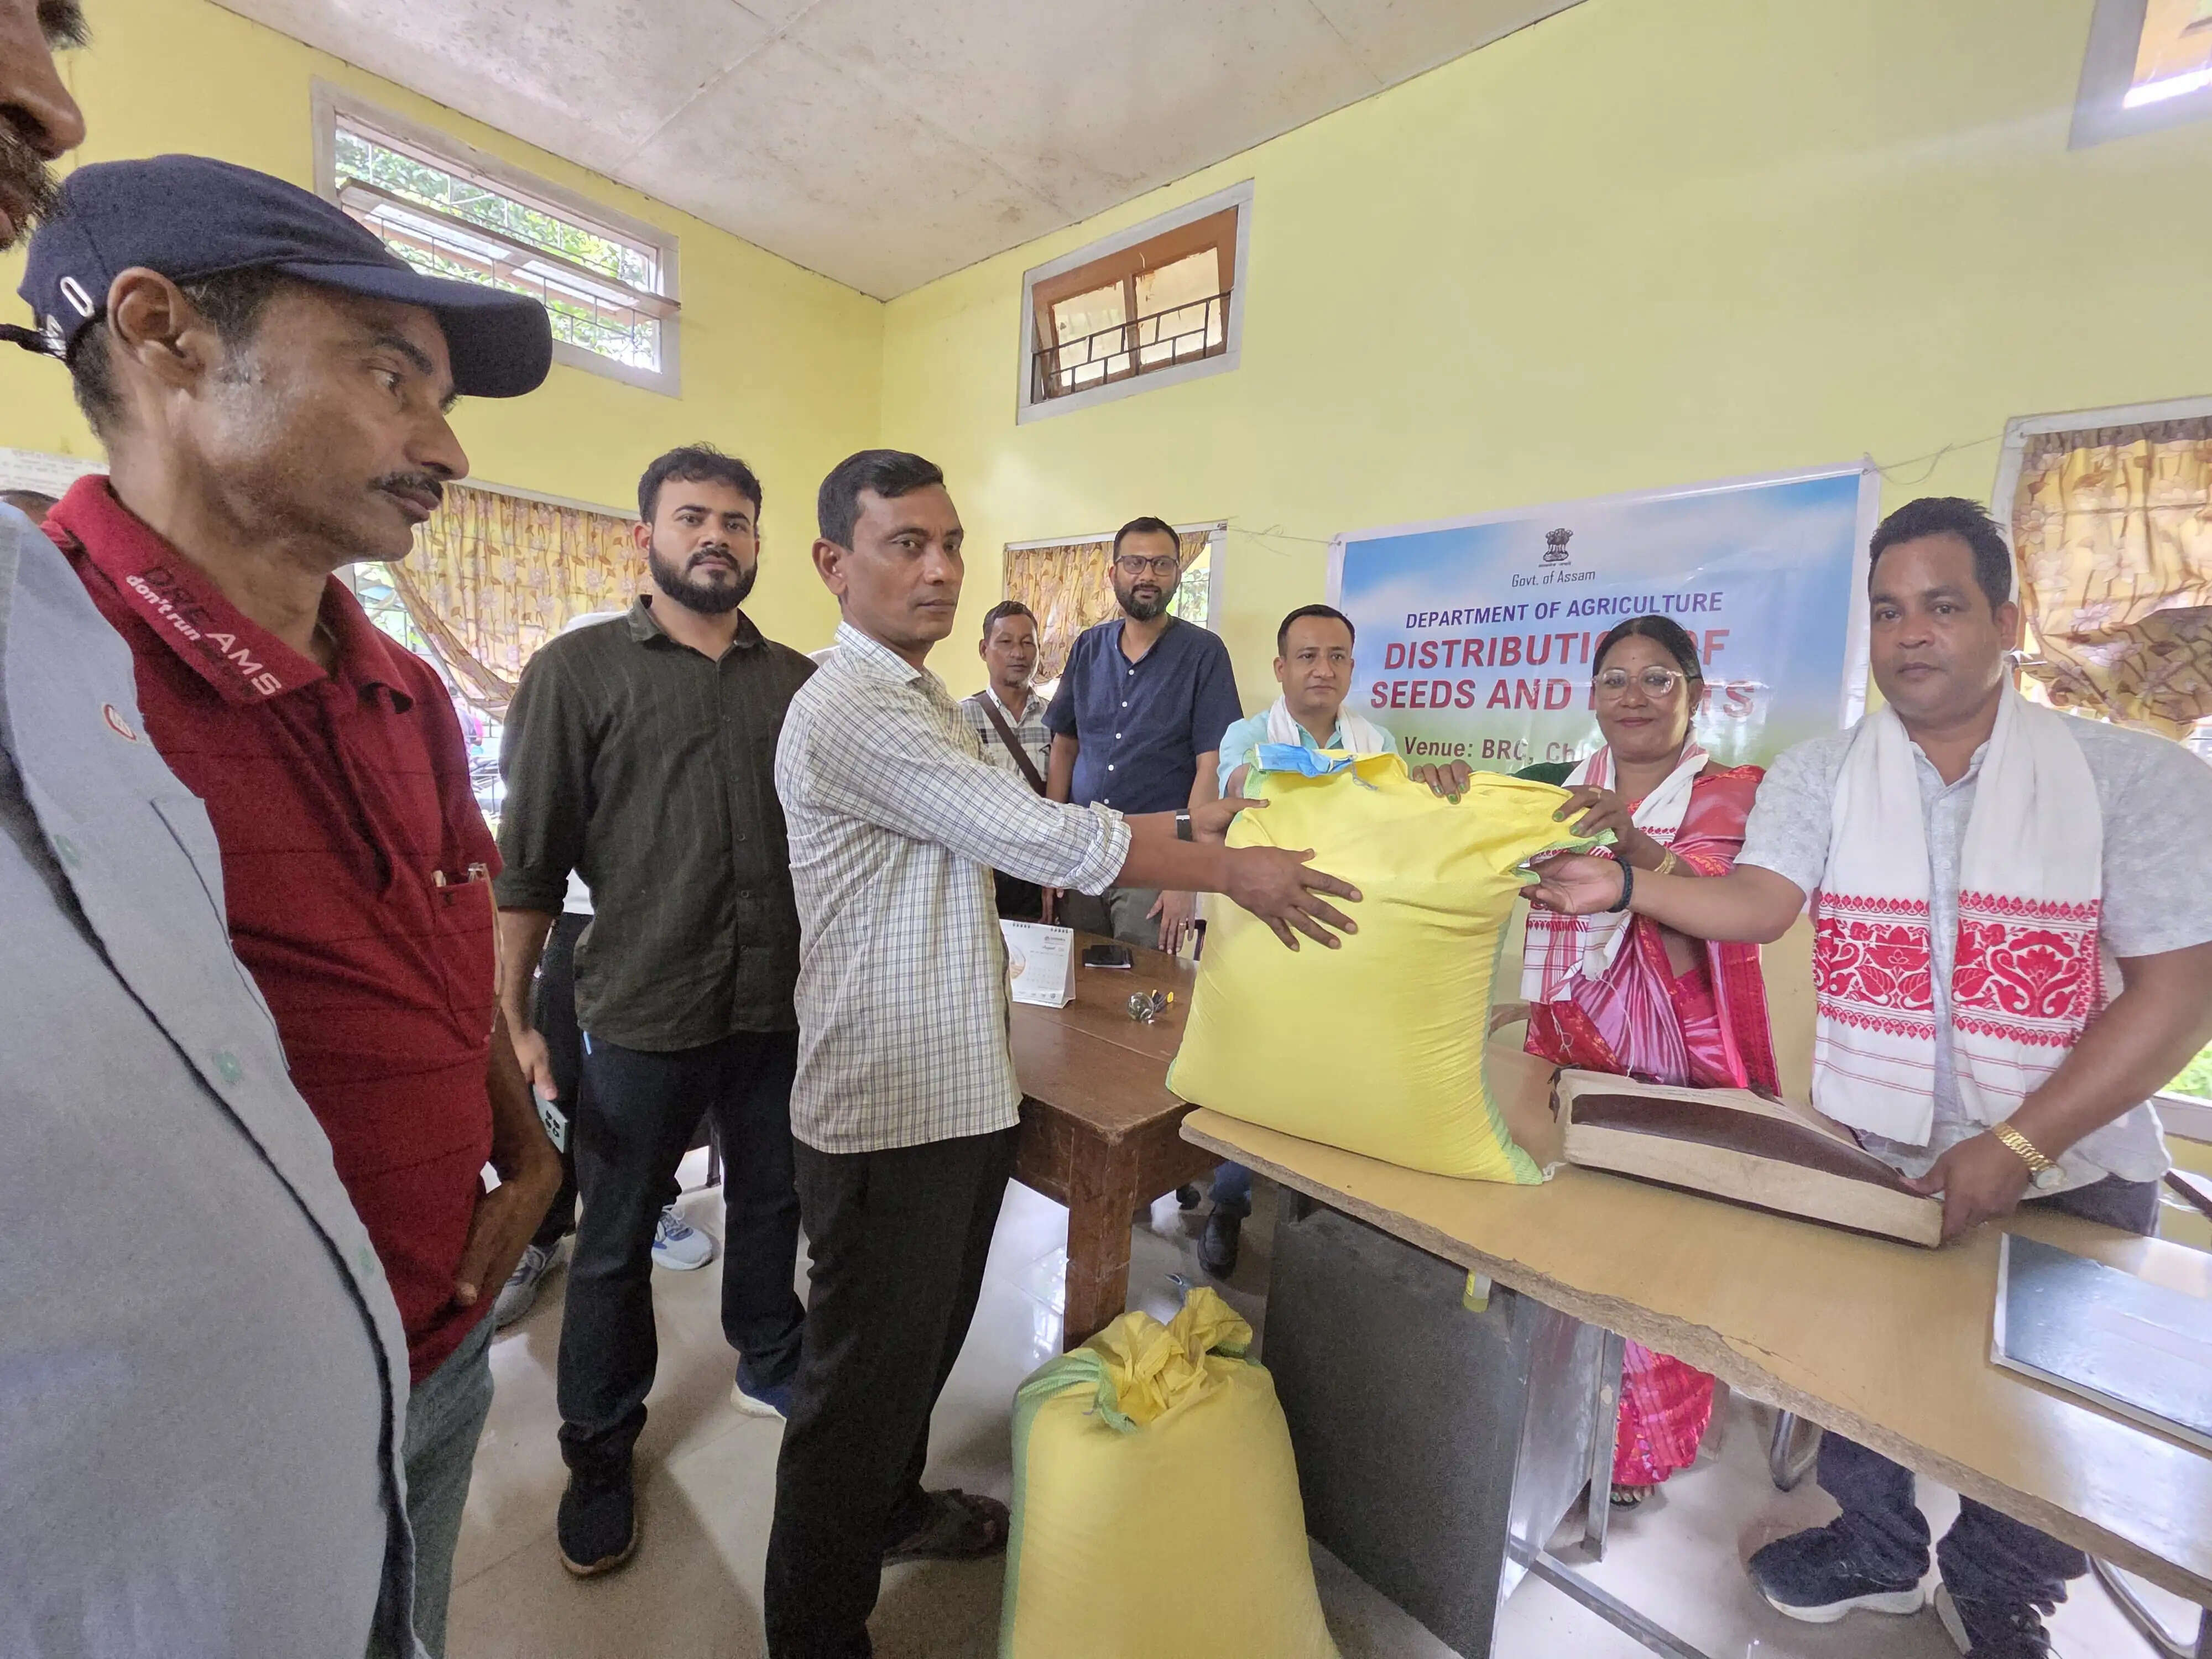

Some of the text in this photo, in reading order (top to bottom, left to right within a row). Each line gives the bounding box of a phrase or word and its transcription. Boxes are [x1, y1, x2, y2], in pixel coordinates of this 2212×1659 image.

[1512, 570, 1595, 587] Govt. of Assam
[1406, 592, 1723, 628] DEPARTMENT OF AGRICULTURE
[166, 613, 201, 640] run
[1385, 629, 1730, 669] DISTRIBUTI F
[1370, 679, 1476, 709] SEEDS
[1486, 678, 1572, 710] AND
[1405, 737, 1473, 757] Venue:
